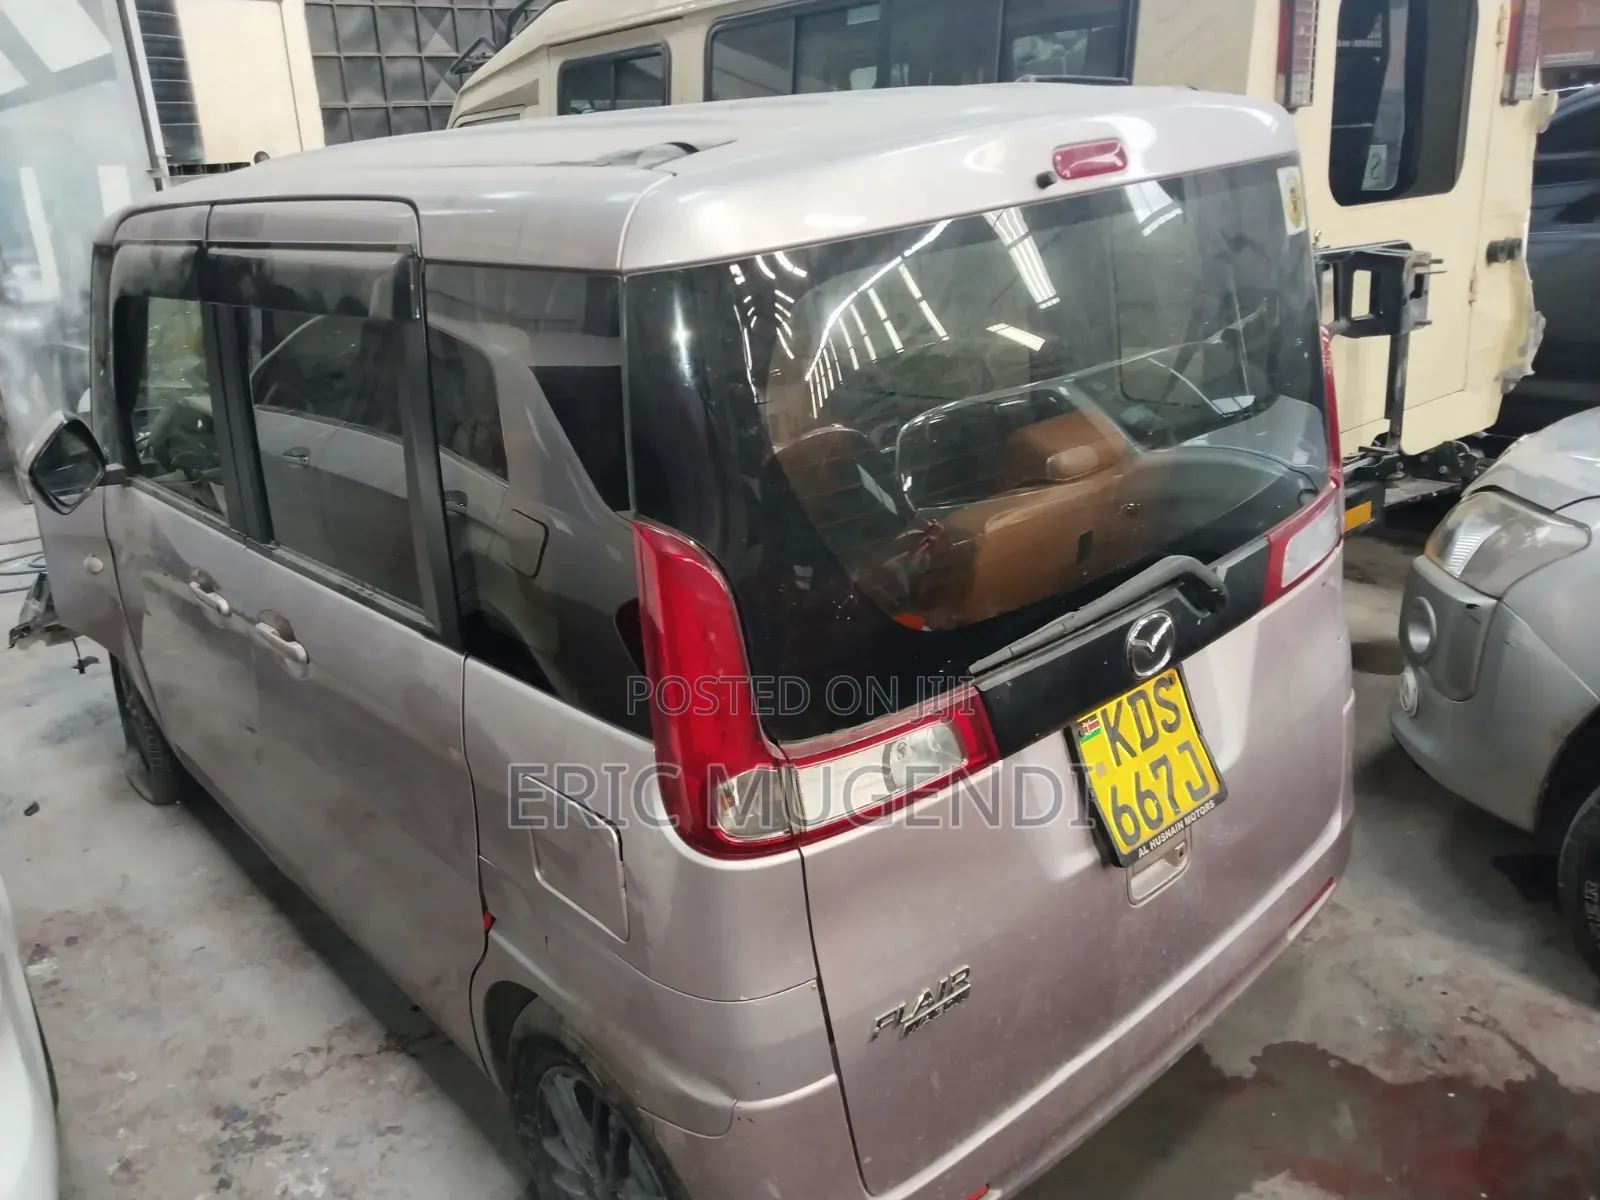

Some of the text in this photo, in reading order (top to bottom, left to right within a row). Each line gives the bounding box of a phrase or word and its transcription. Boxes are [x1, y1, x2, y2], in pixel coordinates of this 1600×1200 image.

[1100, 676, 1180, 767] KDS
[1110, 739, 1210, 847] 667J
[1138, 799, 1215, 858] AL HUSNAIN MOTORS
